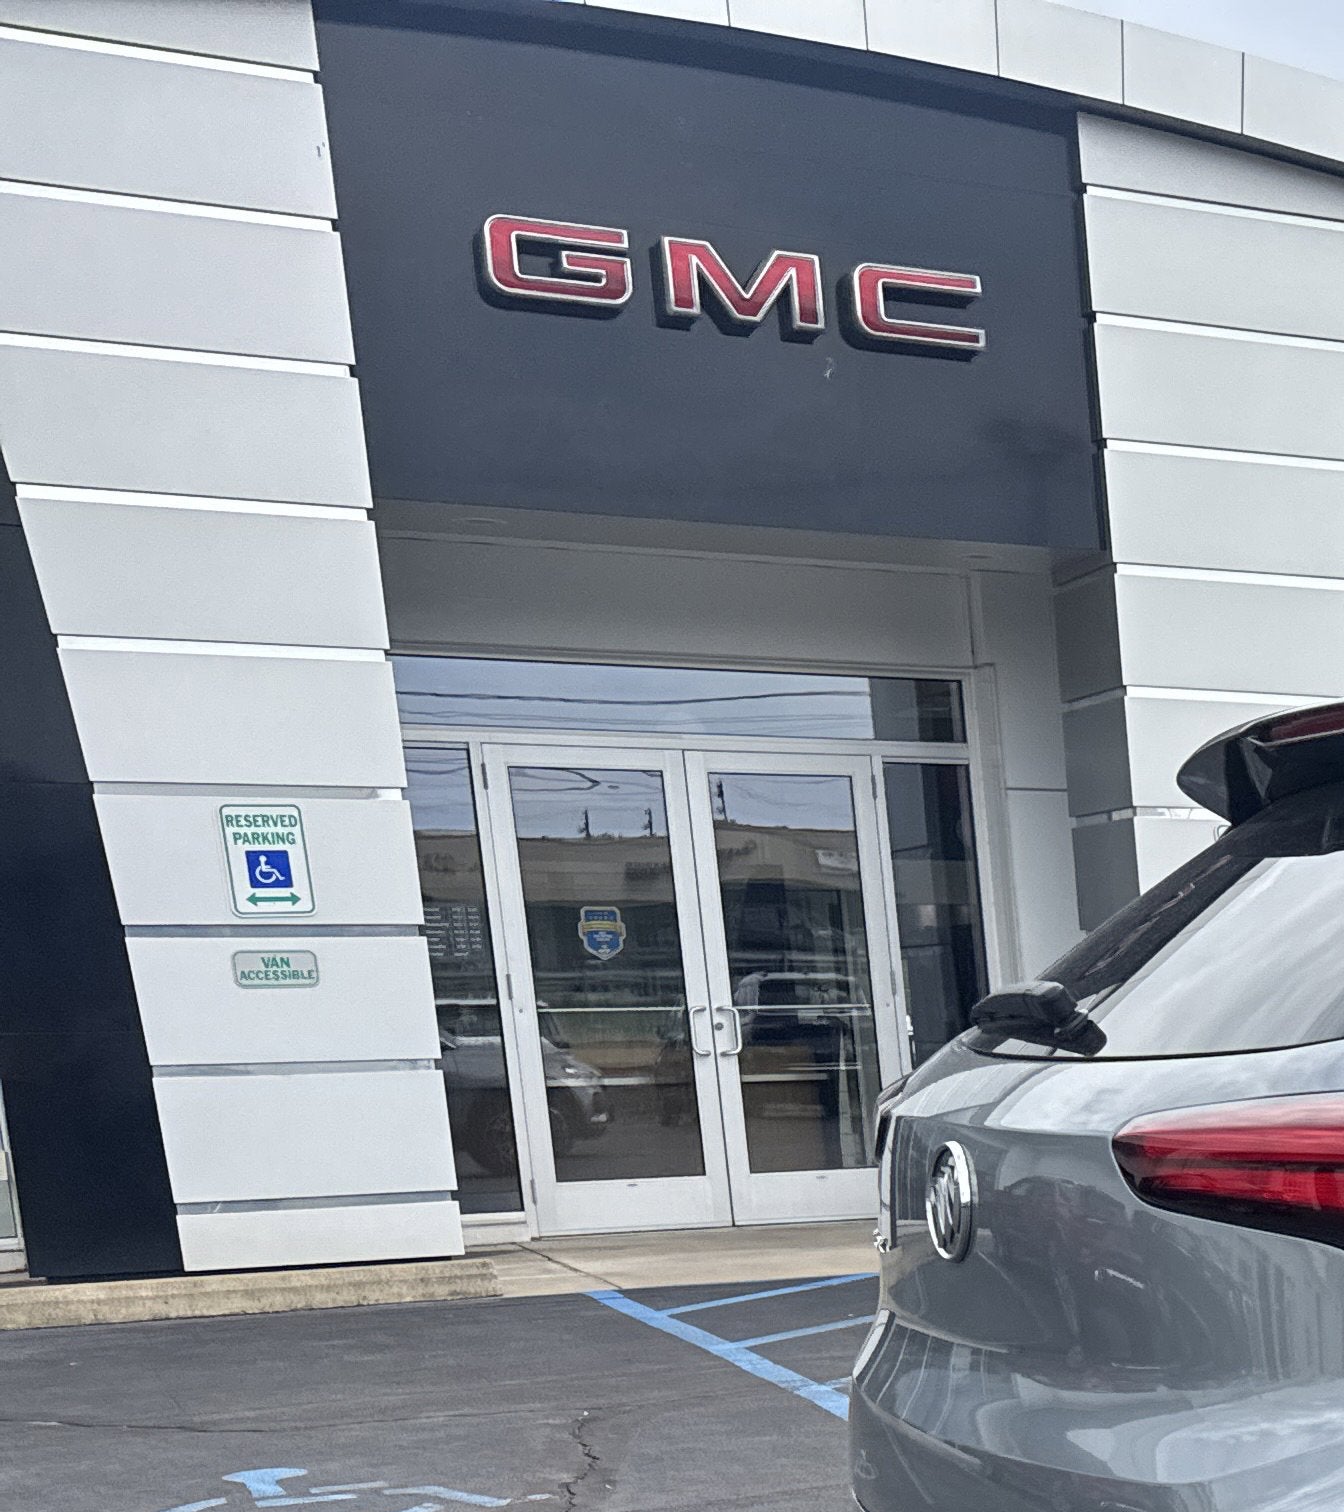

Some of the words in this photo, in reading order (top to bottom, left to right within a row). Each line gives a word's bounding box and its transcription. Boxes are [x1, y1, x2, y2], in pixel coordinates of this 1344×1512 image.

[482, 214, 987, 351] GMC
[224, 814, 298, 828] RESERVED
[232, 832, 296, 846] PARKING
[261, 956, 291, 969] VAN
[239, 970, 315, 981] ACCESSIBLE
